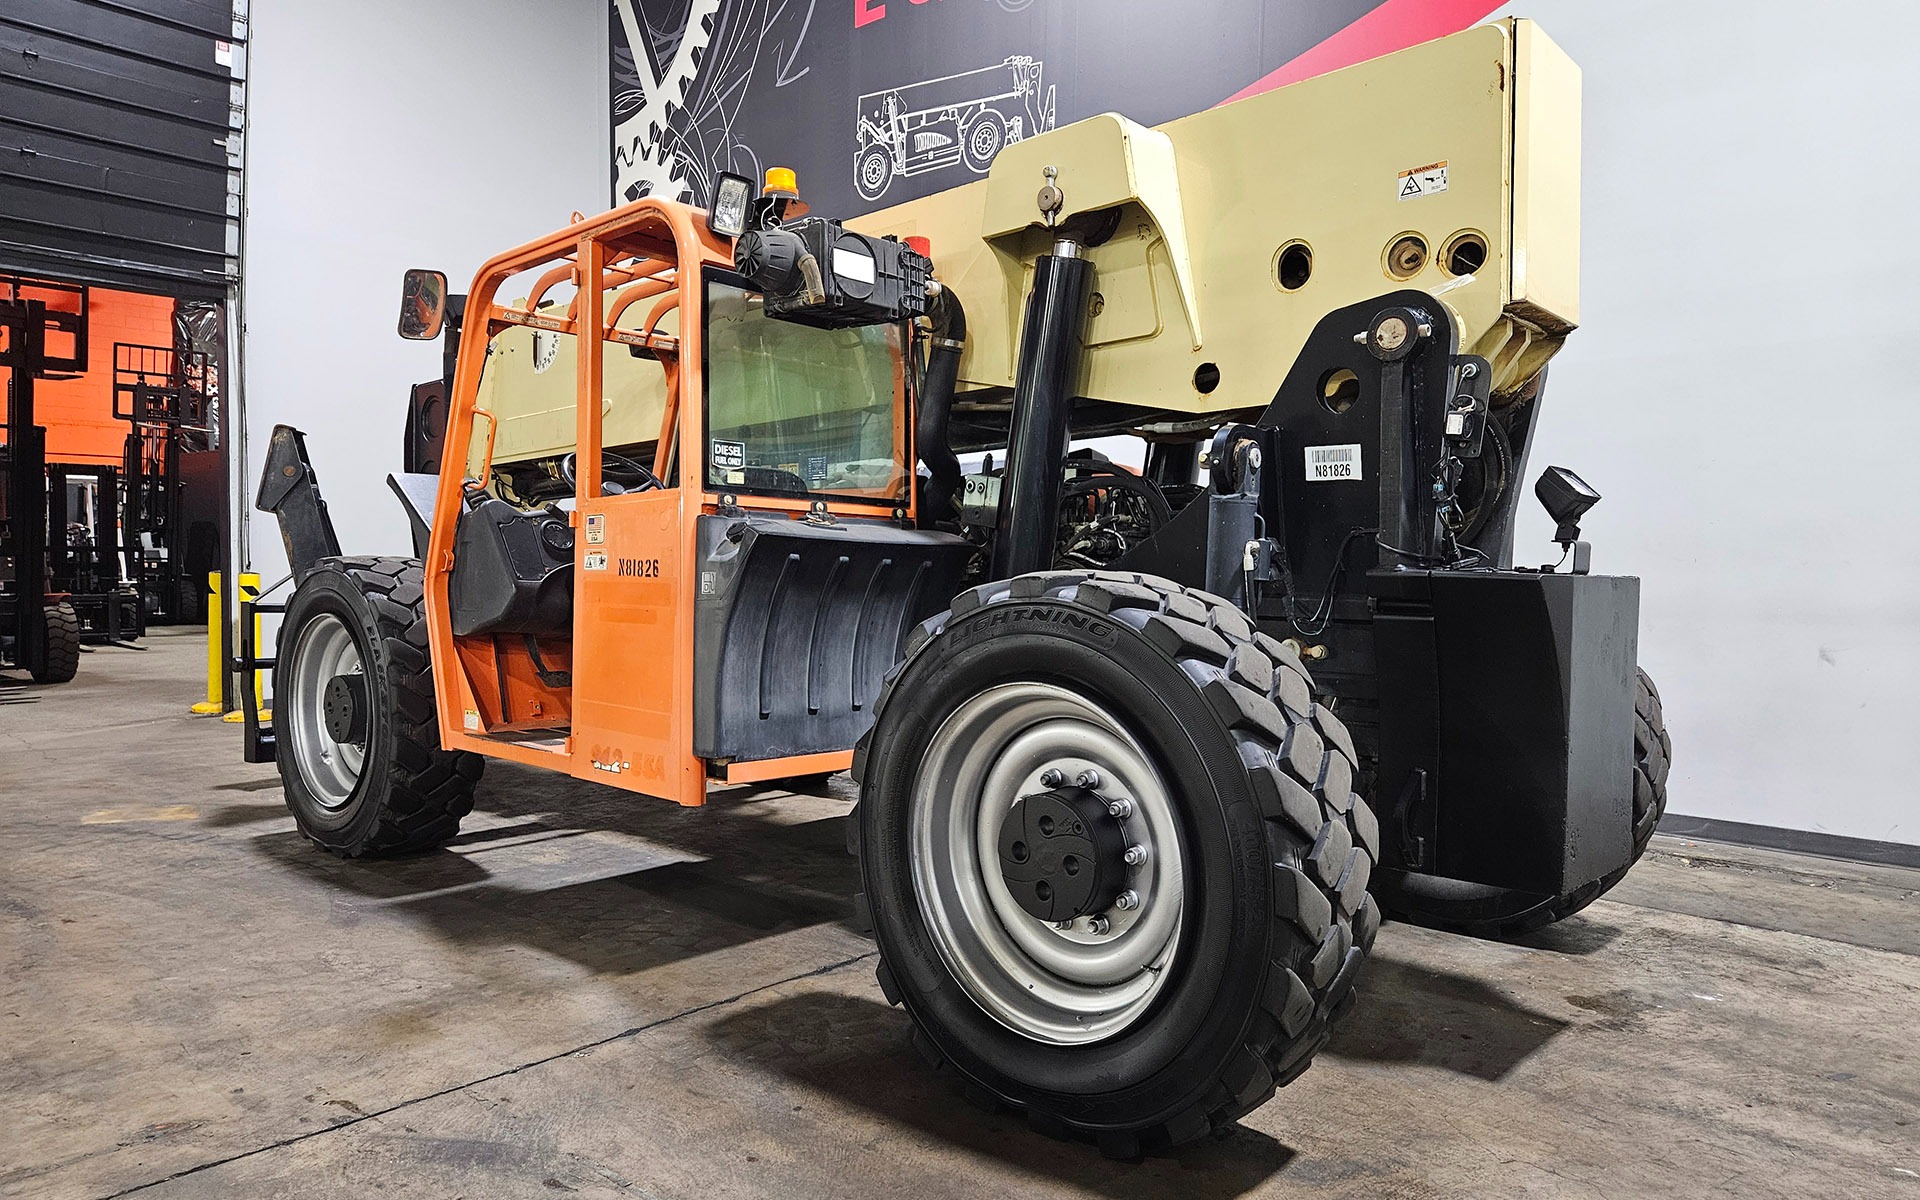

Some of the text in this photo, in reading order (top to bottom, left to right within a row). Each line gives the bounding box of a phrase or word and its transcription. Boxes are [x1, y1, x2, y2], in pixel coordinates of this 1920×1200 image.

[714, 444, 742, 457] DIESEL
[714, 455, 742, 466] FUEL ONLY
[1315, 463, 1351, 477] N81826
[618, 558, 659, 578] N81826
[950, 606, 1115, 648] LIGHTNING
